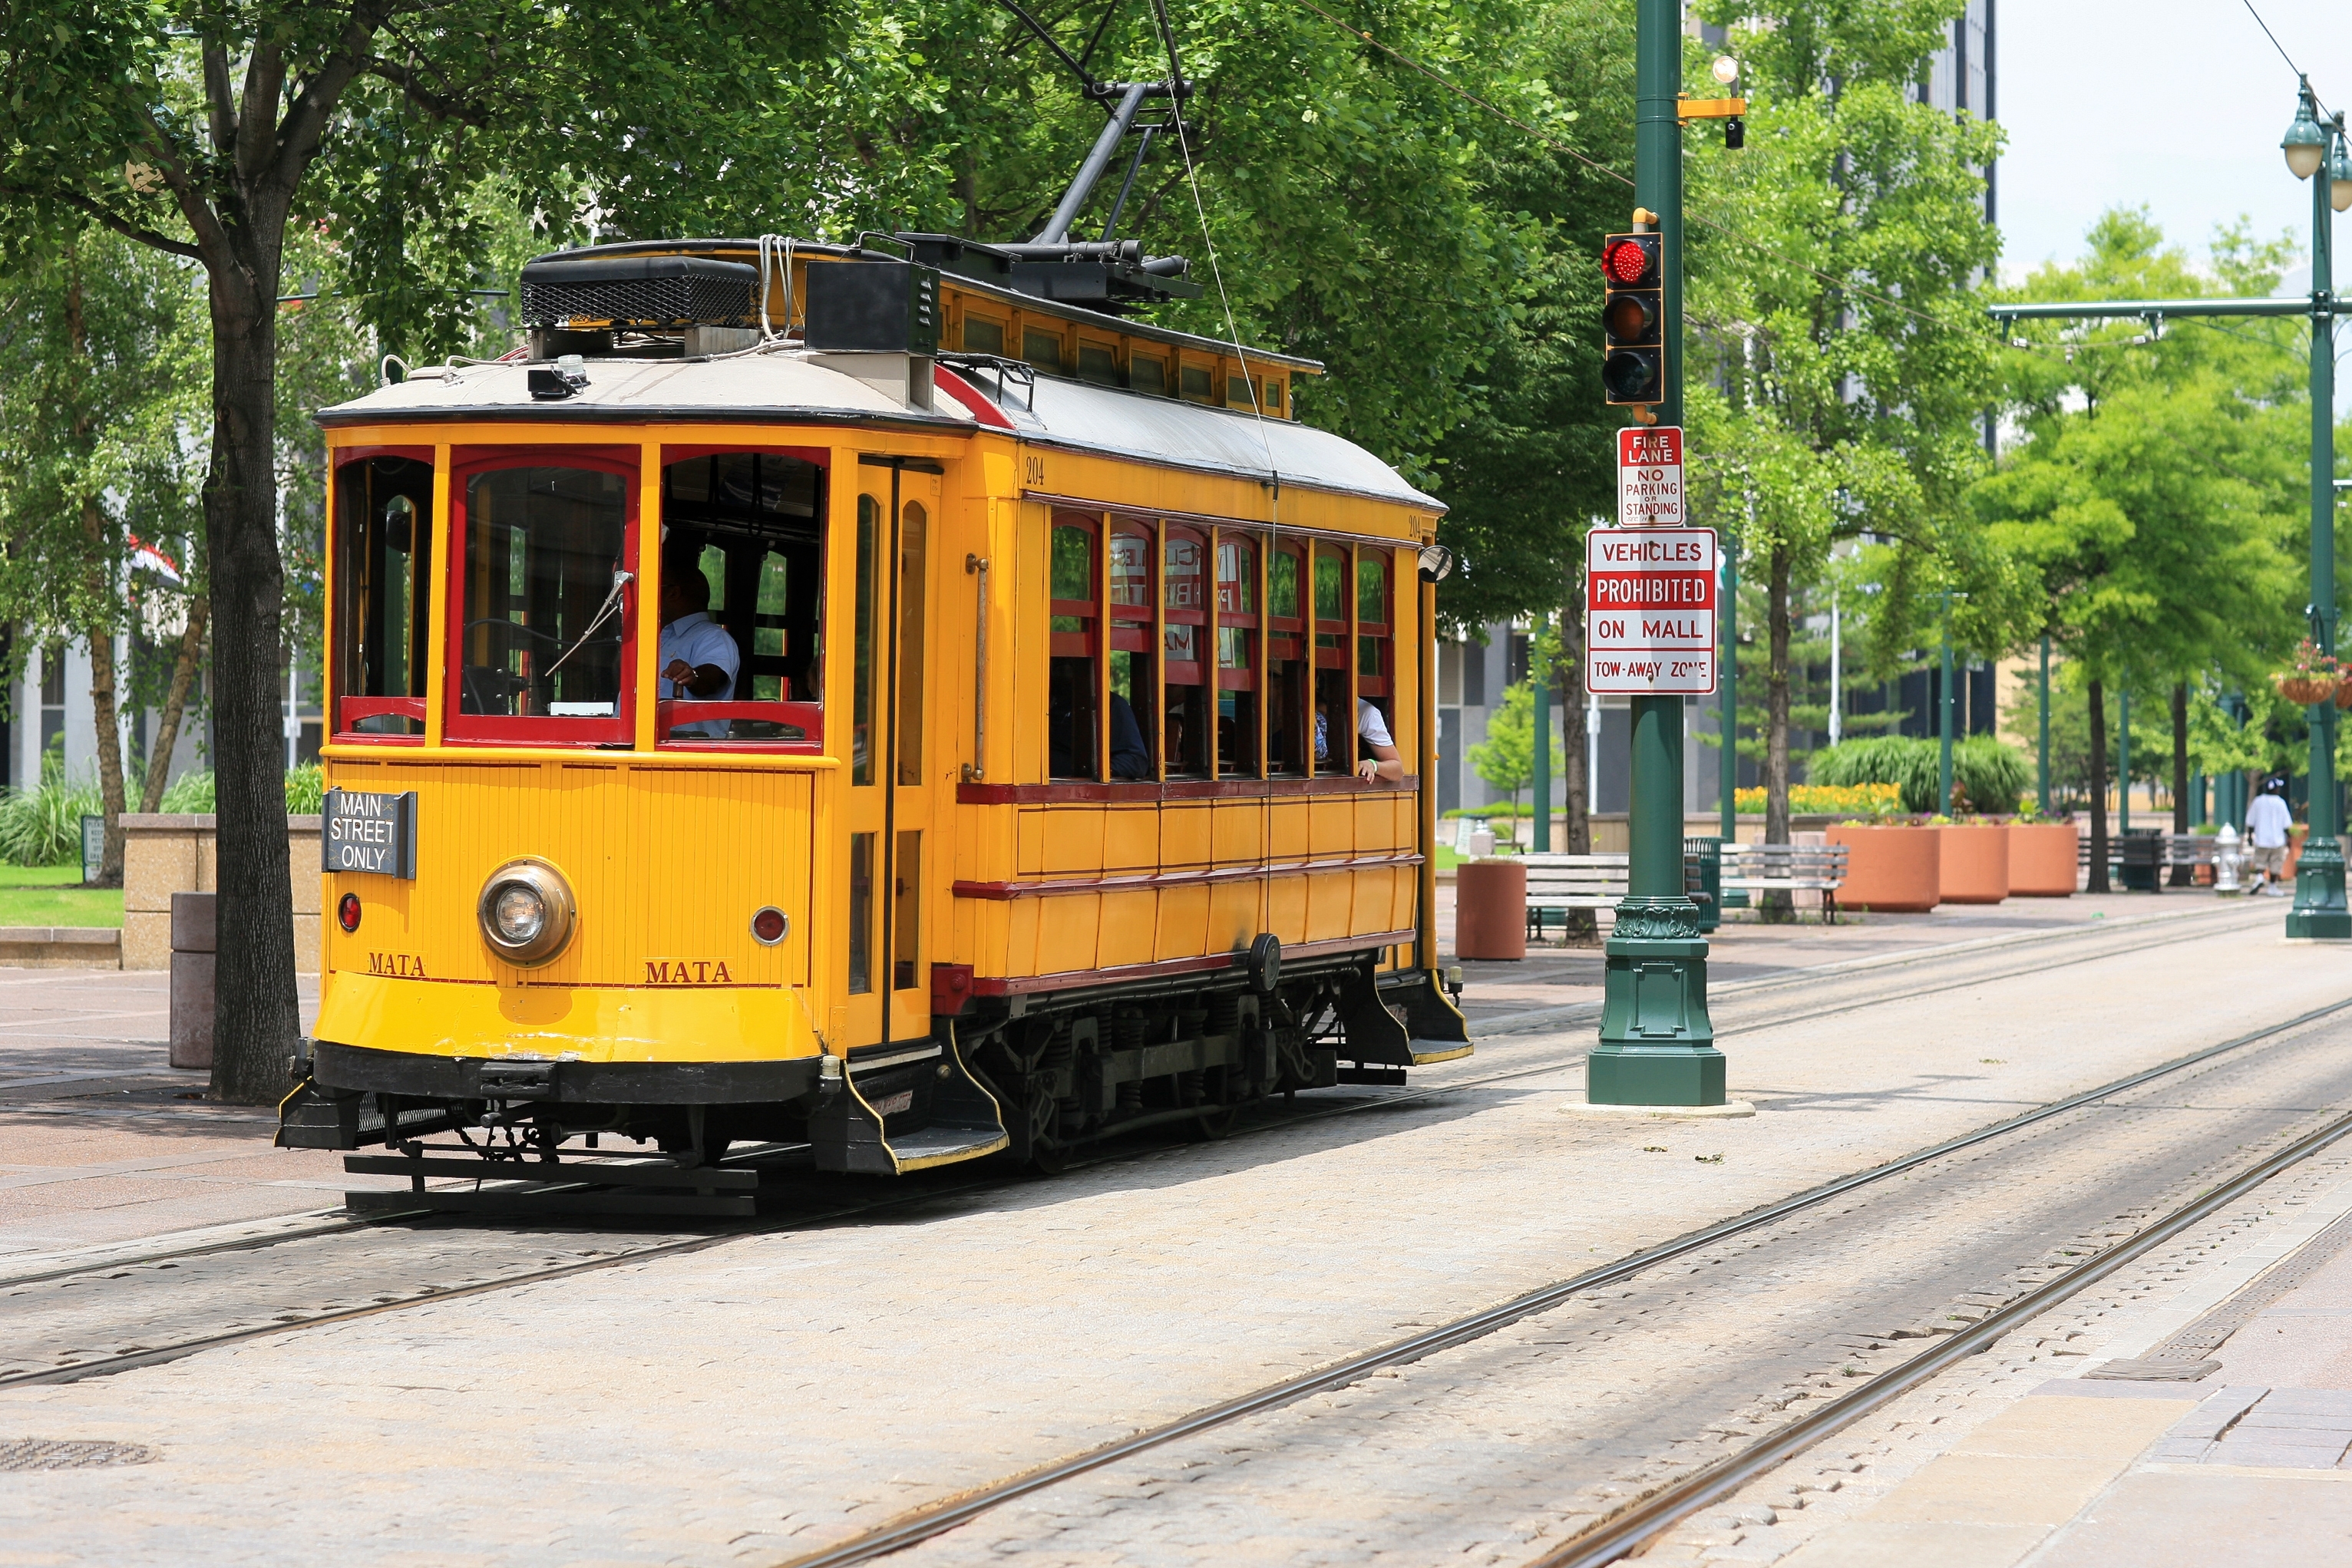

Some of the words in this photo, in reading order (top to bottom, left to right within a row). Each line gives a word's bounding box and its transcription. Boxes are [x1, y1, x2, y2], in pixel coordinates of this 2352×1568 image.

[1633, 436, 1669, 449] FIRE
[1628, 449, 1673, 464] LANE
[1026, 456, 1044, 486] 204
[1637, 469, 1664, 482] NO
[1626, 482, 1677, 497] PARKING
[1626, 502, 1678, 516] STANDING
[1409, 514, 1421, 539] 204
[1602, 543, 1703, 562] VEHICLES
[1596, 578, 1706, 603] PROHIBITED
[1598, 619, 1625, 639] ON
[1642, 619, 1704, 639] MALL
[1594, 661, 1663, 678] TOW-AWAY
[340, 793, 382, 817] MAIN
[330, 817, 394, 843] STREET
[341, 844, 386, 870] ONLY
[368, 952, 426, 977] MATA
[645, 961, 732, 983] MATA
